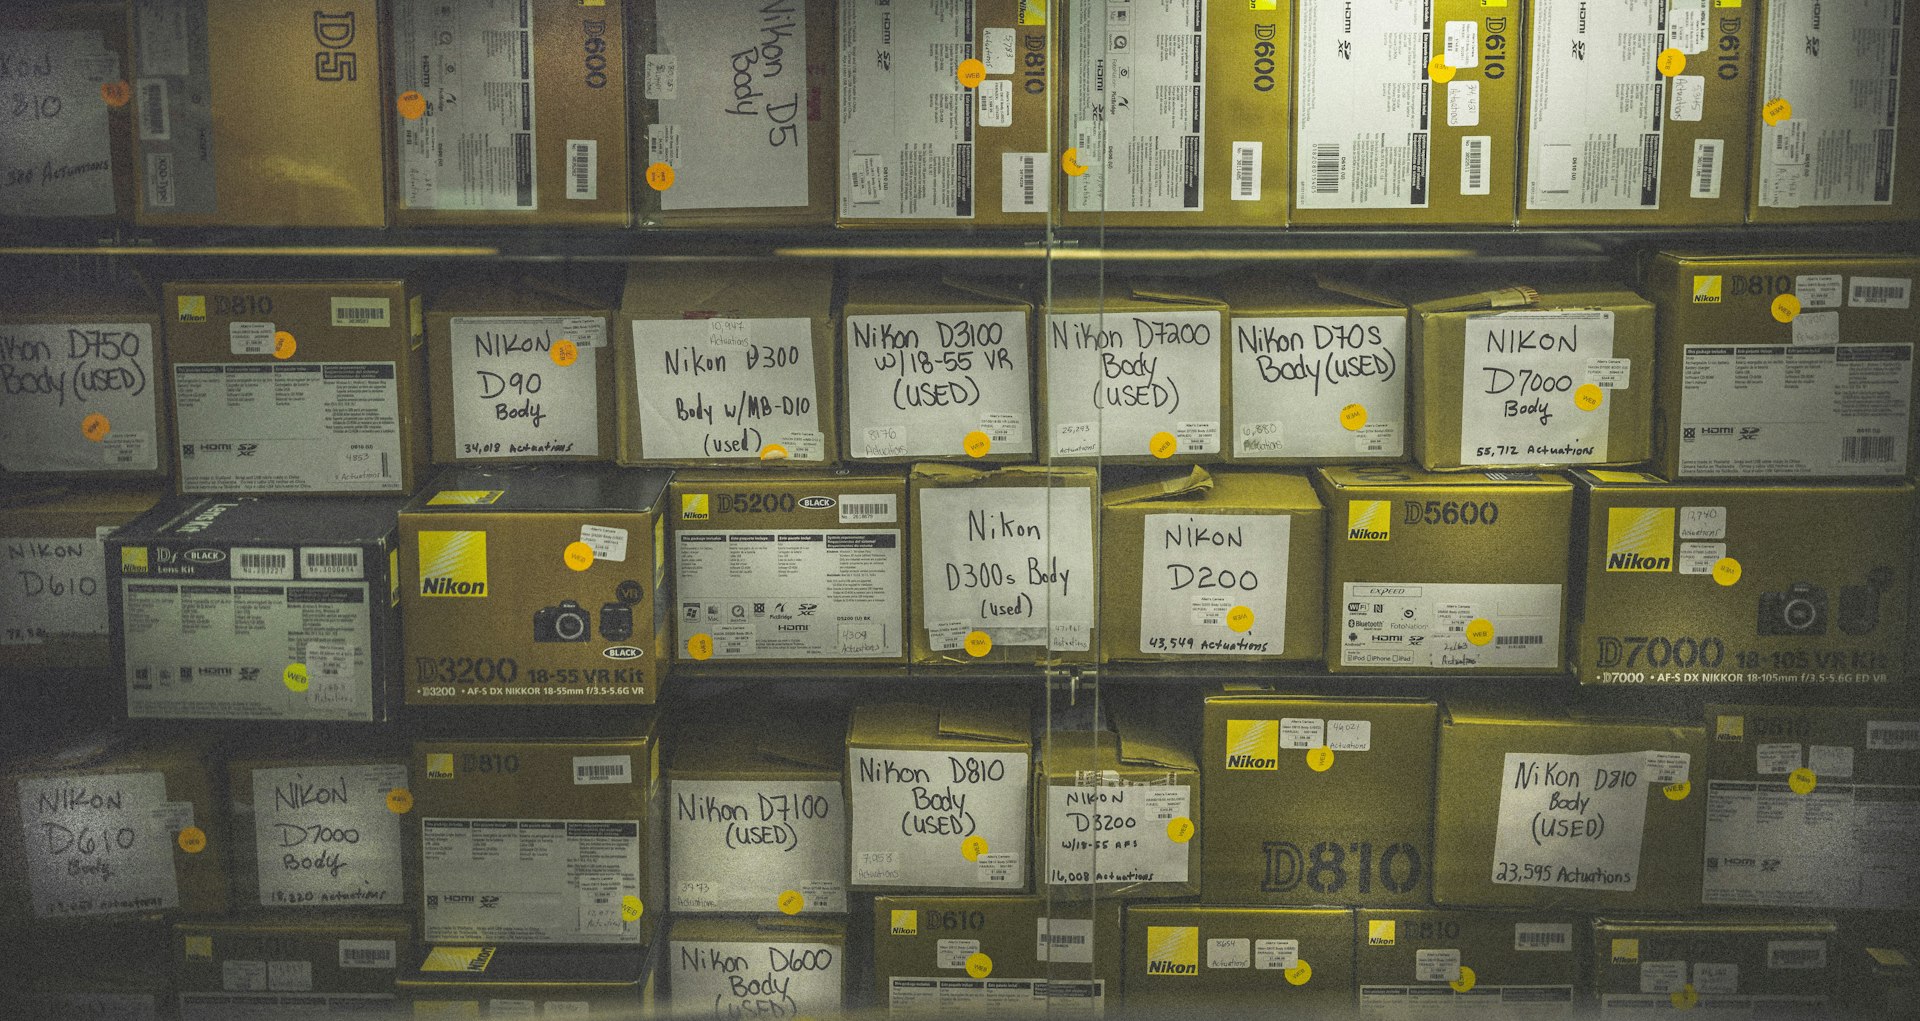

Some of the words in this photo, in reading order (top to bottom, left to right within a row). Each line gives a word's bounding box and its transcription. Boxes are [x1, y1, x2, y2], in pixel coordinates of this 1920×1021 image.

[313, 10, 357, 82] D5
[583, 19, 608, 89] D600
[1253, 24, 1276, 92] D600
[1483, 17, 1507, 80] D610
[1717, 17, 1741, 81] D610
[1023, 35, 1046, 95] D810
[724, 46, 764, 116] Body
[766, 93, 799, 147] D5
[1693, 294, 1720, 304] Nikon
[1731, 275, 1791, 296] D810
[179, 313, 206, 323] Nikon
[67, 329, 140, 360] D750
[475, 330, 551, 357] NIKON
[853, 320, 919, 350] Nikon
[935, 321, 1003, 348] D3100
[1052, 320, 1123, 351] Nikon
[1131, 317, 1211, 347] D7200
[1238, 324, 1303, 354] Nikon
[1486, 324, 1577, 354] NIKON
[664, 350, 727, 376] Nikon
[987, 350, 1014, 371] VR
[1100, 352, 1158, 388] Body
[1256, 354, 1322, 397] Body
[1324, 347, 1397, 384] (USED)
[72, 361, 147, 402] (USED)
[475, 371, 542, 399] D90
[892, 376, 981, 411] (USED)
[1482, 366, 1574, 395] D7000
[1092, 376, 1181, 415] (USED)
[494, 399, 546, 428] Body
[675, 397, 714, 425] Body
[1503, 399, 1554, 427] Body
[509, 440, 575, 453] Actuations
[703, 427, 763, 457] (used)
[1475, 446, 1519, 458] 55,712
[1526, 438, 1596, 456] Actuations
[683, 510, 708, 519] Nikon
[717, 492, 796, 514] D5200
[803, 498, 830, 507] BLACK
[1404, 501, 1499, 526] D5600
[968, 509, 1041, 542] Nikon
[1164, 517, 1243, 550] NIKON
[1349, 528, 1389, 540] Nikon
[6, 542, 84, 559] NIKON
[190, 551, 219, 560] BLACK
[1608, 553, 1670, 570] Nikon
[157, 565, 179, 574] Lens
[181, 565, 195, 574] Kit
[945, 561, 1016, 592] D300s
[1027, 557, 1071, 596] Body
[1167, 564, 1259, 592] D200
[18, 569, 97, 598] D610
[422, 577, 485, 595] Nikon
[980, 592, 1034, 619] (used)
[778, 624, 809, 632] HDMI
[1355, 620, 1384, 628] Bluetooth
[1149, 637, 1194, 651] 43,549
[1200, 629, 1268, 652] Actuations
[1371, 634, 1403, 642] HDMI
[608, 649, 637, 657] BLACK
[1596, 637, 1726, 669] D7000
[287, 672, 307, 684] WEB
[415, 657, 518, 684] D3200
[526, 669, 579, 684] 18-55
[583, 669, 611, 684] VR
[614, 668, 645, 684] Kit
[1602, 672, 1645, 684] D7000
[1657, 672, 1681, 683] AF-S
[1683, 672, 1699, 683] DX
[1702, 672, 1744, 683] NIKKOR
[1746, 672, 1798, 683] 18-105mm
[467, 686, 487, 695] AF-S
[489, 686, 503, 695] DX
[505, 686, 541, 695] NIKKOR
[543, 686, 584, 695] 18-55mm
[631, 687, 644, 695] VR
[1717, 732, 1743, 742] Nikon
[428, 771, 453, 779] Nikon
[859, 757, 930, 784] Nikon
[948, 757, 1005, 783] D810
[1227, 755, 1276, 770] Nikon
[1514, 762, 1580, 790] Nikon
[1595, 770, 1638, 790] D810
[38, 785, 122, 814] NIKON
[274, 773, 348, 811] NIKON
[1065, 790, 1124, 806] NIKON
[1664, 783, 1685, 793] WEB
[678, 792, 748, 822] Nikon
[758, 793, 829, 822] D7100
[912, 787, 966, 819] Body
[1549, 792, 1591, 815] Body
[273, 823, 360, 848] D7000
[902, 812, 976, 837] (USED)
[1066, 812, 1137, 833] D3200
[1531, 812, 1605, 846] (USED)
[43, 821, 136, 856] D610
[725, 822, 797, 852] (USED)
[282, 851, 347, 877] Body
[1260, 841, 1423, 893] D810
[1495, 862, 1553, 884] 23,595
[1556, 866, 1632, 885] Actuations
[892, 927, 916, 935] Nikon
[926, 911, 986, 931] D610
[1369, 937, 1394, 945] Nikon
[680, 946, 749, 974] Nikon
[767, 947, 833, 972] D600
[1148, 959, 1197, 975] Nikon
[728, 973, 790, 999] Body
